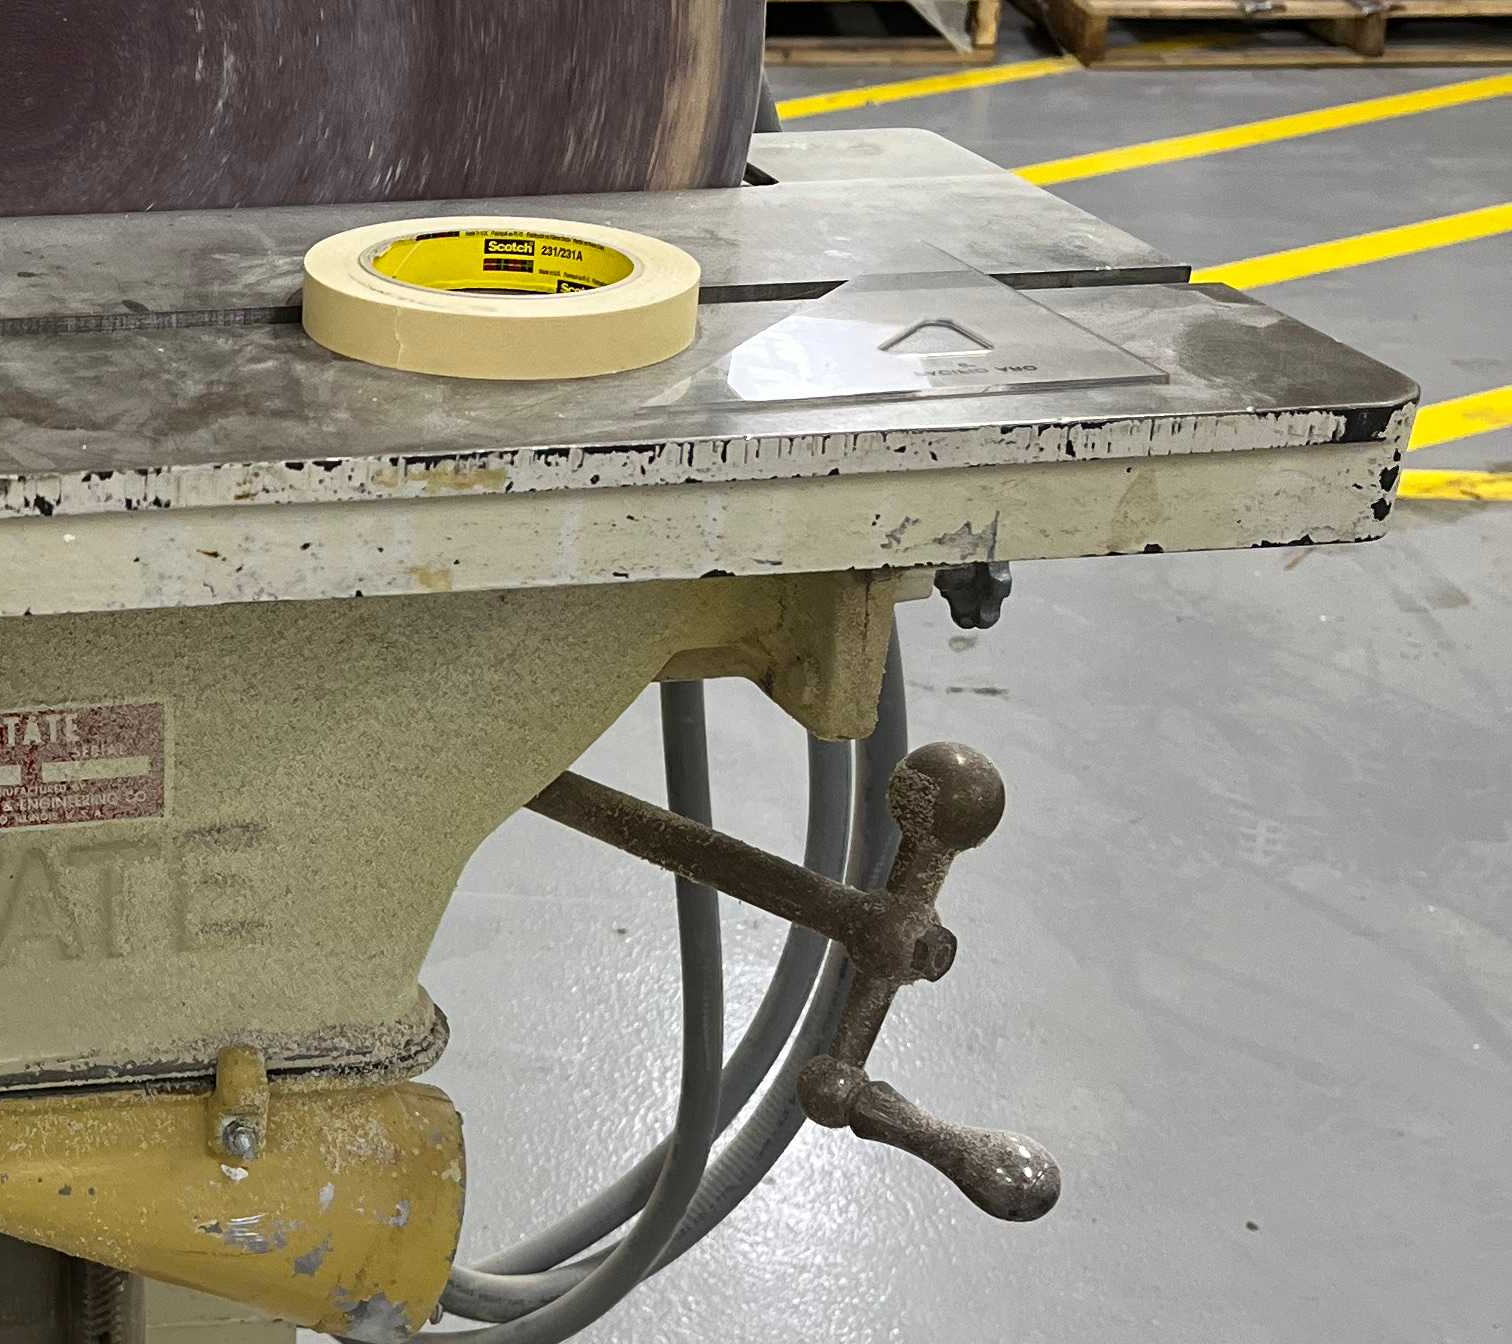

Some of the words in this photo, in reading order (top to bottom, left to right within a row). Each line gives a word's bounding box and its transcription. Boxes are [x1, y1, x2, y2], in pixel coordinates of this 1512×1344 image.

[488, 240, 533, 254] Scotch
[541, 245, 583, 262] 231/231A
[19, 792, 118, 811] ENGINEERING
